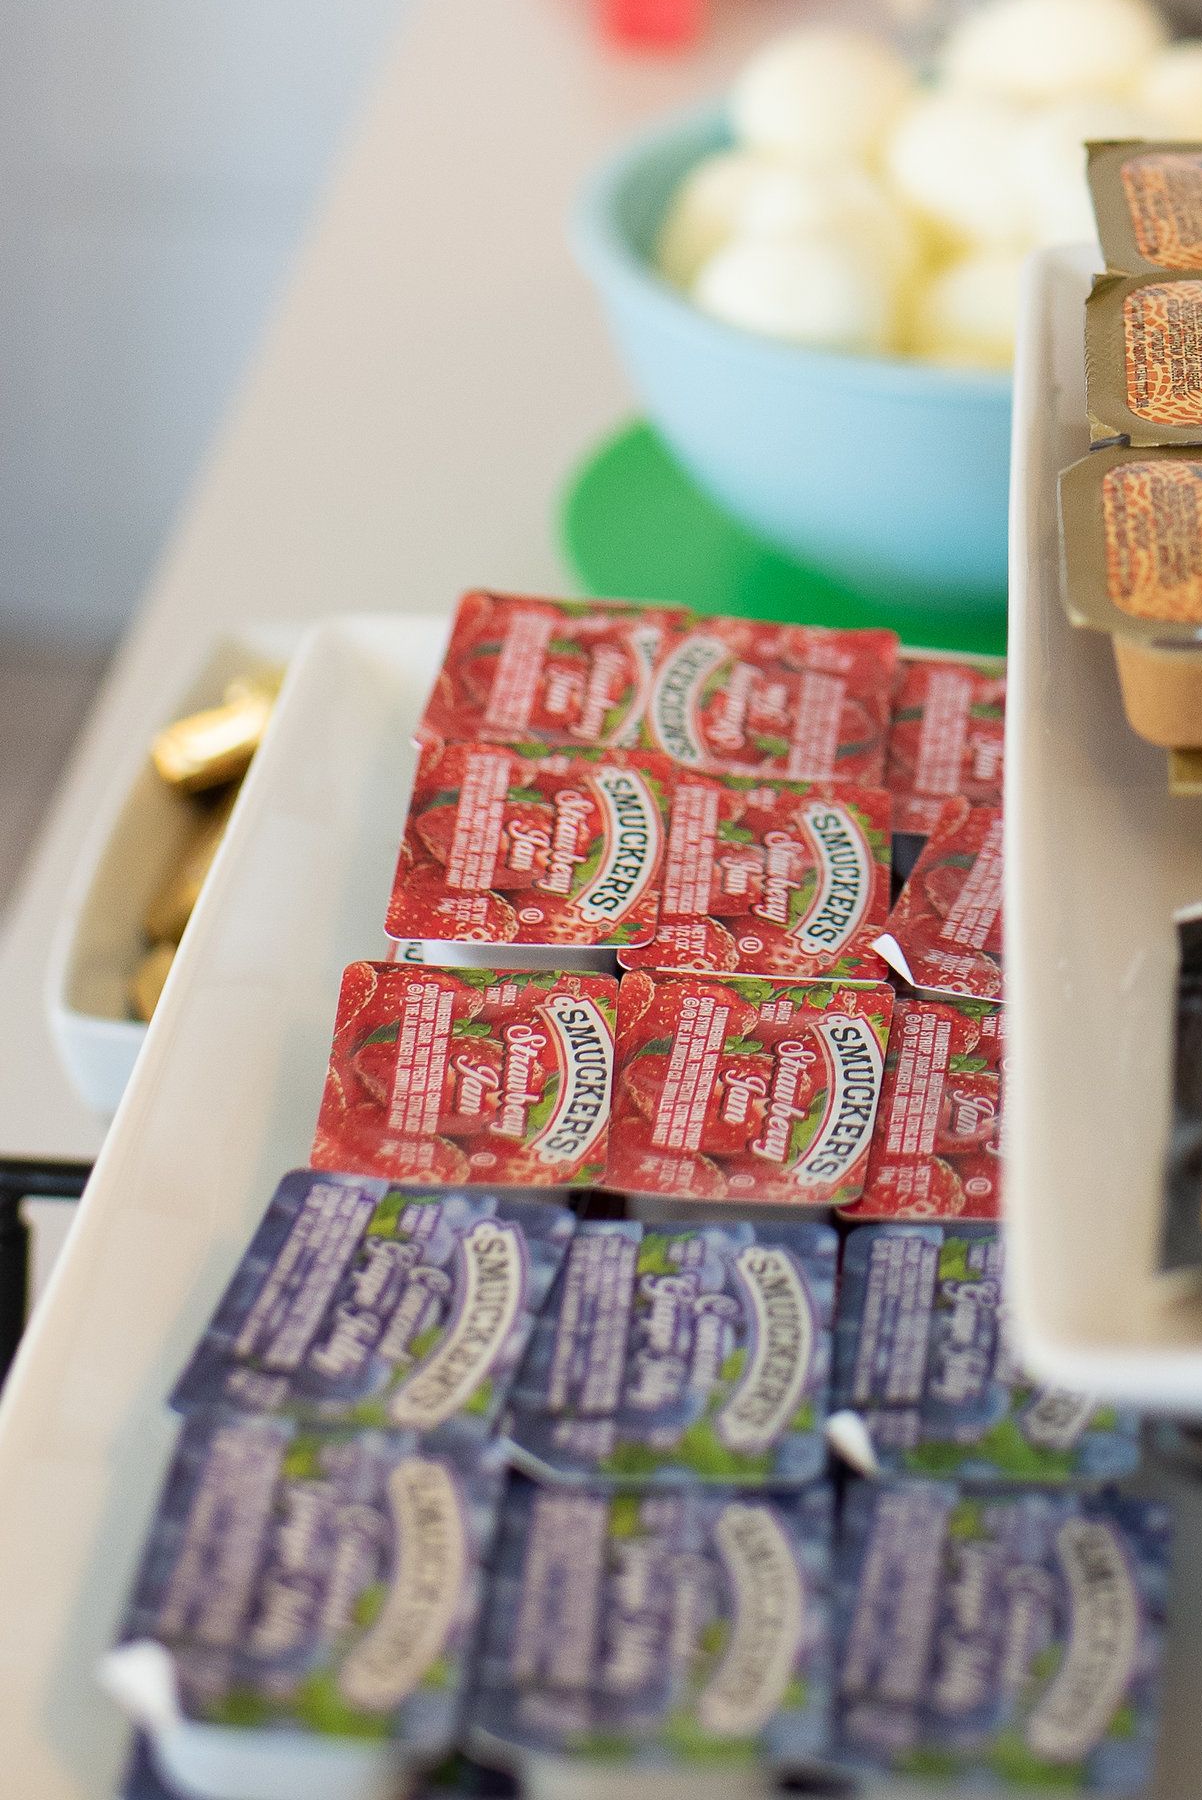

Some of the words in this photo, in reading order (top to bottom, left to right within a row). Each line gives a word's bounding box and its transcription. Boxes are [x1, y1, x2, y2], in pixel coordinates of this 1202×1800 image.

[508, 820, 550, 871] Jam
[536, 790, 594, 894] Strawberry
[588, 779, 648, 912] SMUCKER'S
[806, 814, 862, 943] SMUCKER'S
[675, 938, 689, 950] OZ
[676, 925, 690, 936] 1/2
[690, 940, 704, 956] WT
[692, 924, 706, 940] NET
[777, 1001, 792, 1019] GRADE
[981, 1016, 996, 1036] FANCY
[414, 1047, 430, 1066] FRUIT
[416, 1023, 433, 1046] SUGAR,
[917, 1032, 934, 1054] SYRUP,
[930, 1021, 951, 1072] STRAWBERRIES,
[428, 1054, 445, 1092] FRUCTOSE
[456, 1055, 498, 1116] Jam
[490, 1025, 546, 1136] Strawberry
[546, 1009, 608, 1154] SMUCKER'S
[723, 1070, 766, 1123] Jam
[754, 1040, 816, 1162] Strawberry
[806, 1027, 875, 1176] SMUCKER'S
[953, 1090, 994, 1135] Jam
